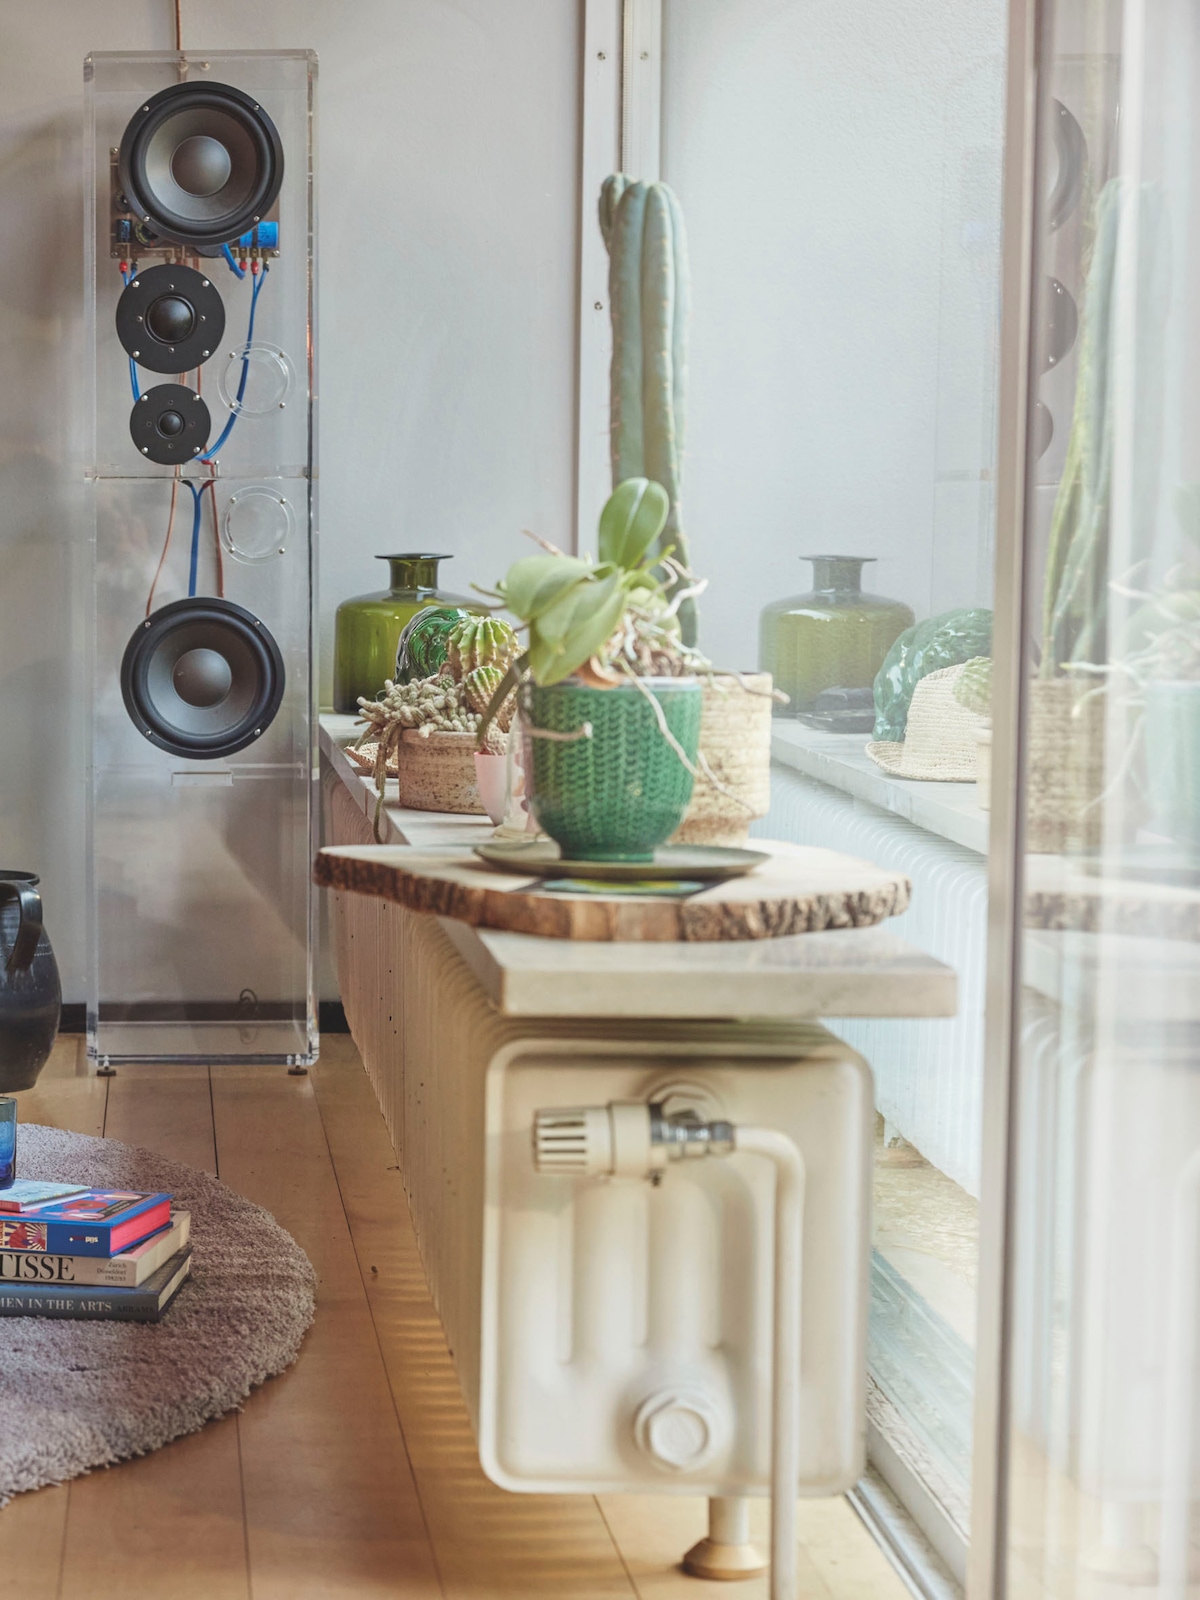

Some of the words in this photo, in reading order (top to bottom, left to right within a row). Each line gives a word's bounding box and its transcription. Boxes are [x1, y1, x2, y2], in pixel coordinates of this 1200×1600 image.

[28, 1298, 43, 1308] IN
[46, 1299, 75, 1310] THE
[79, 1300, 112, 1312] ARTS
